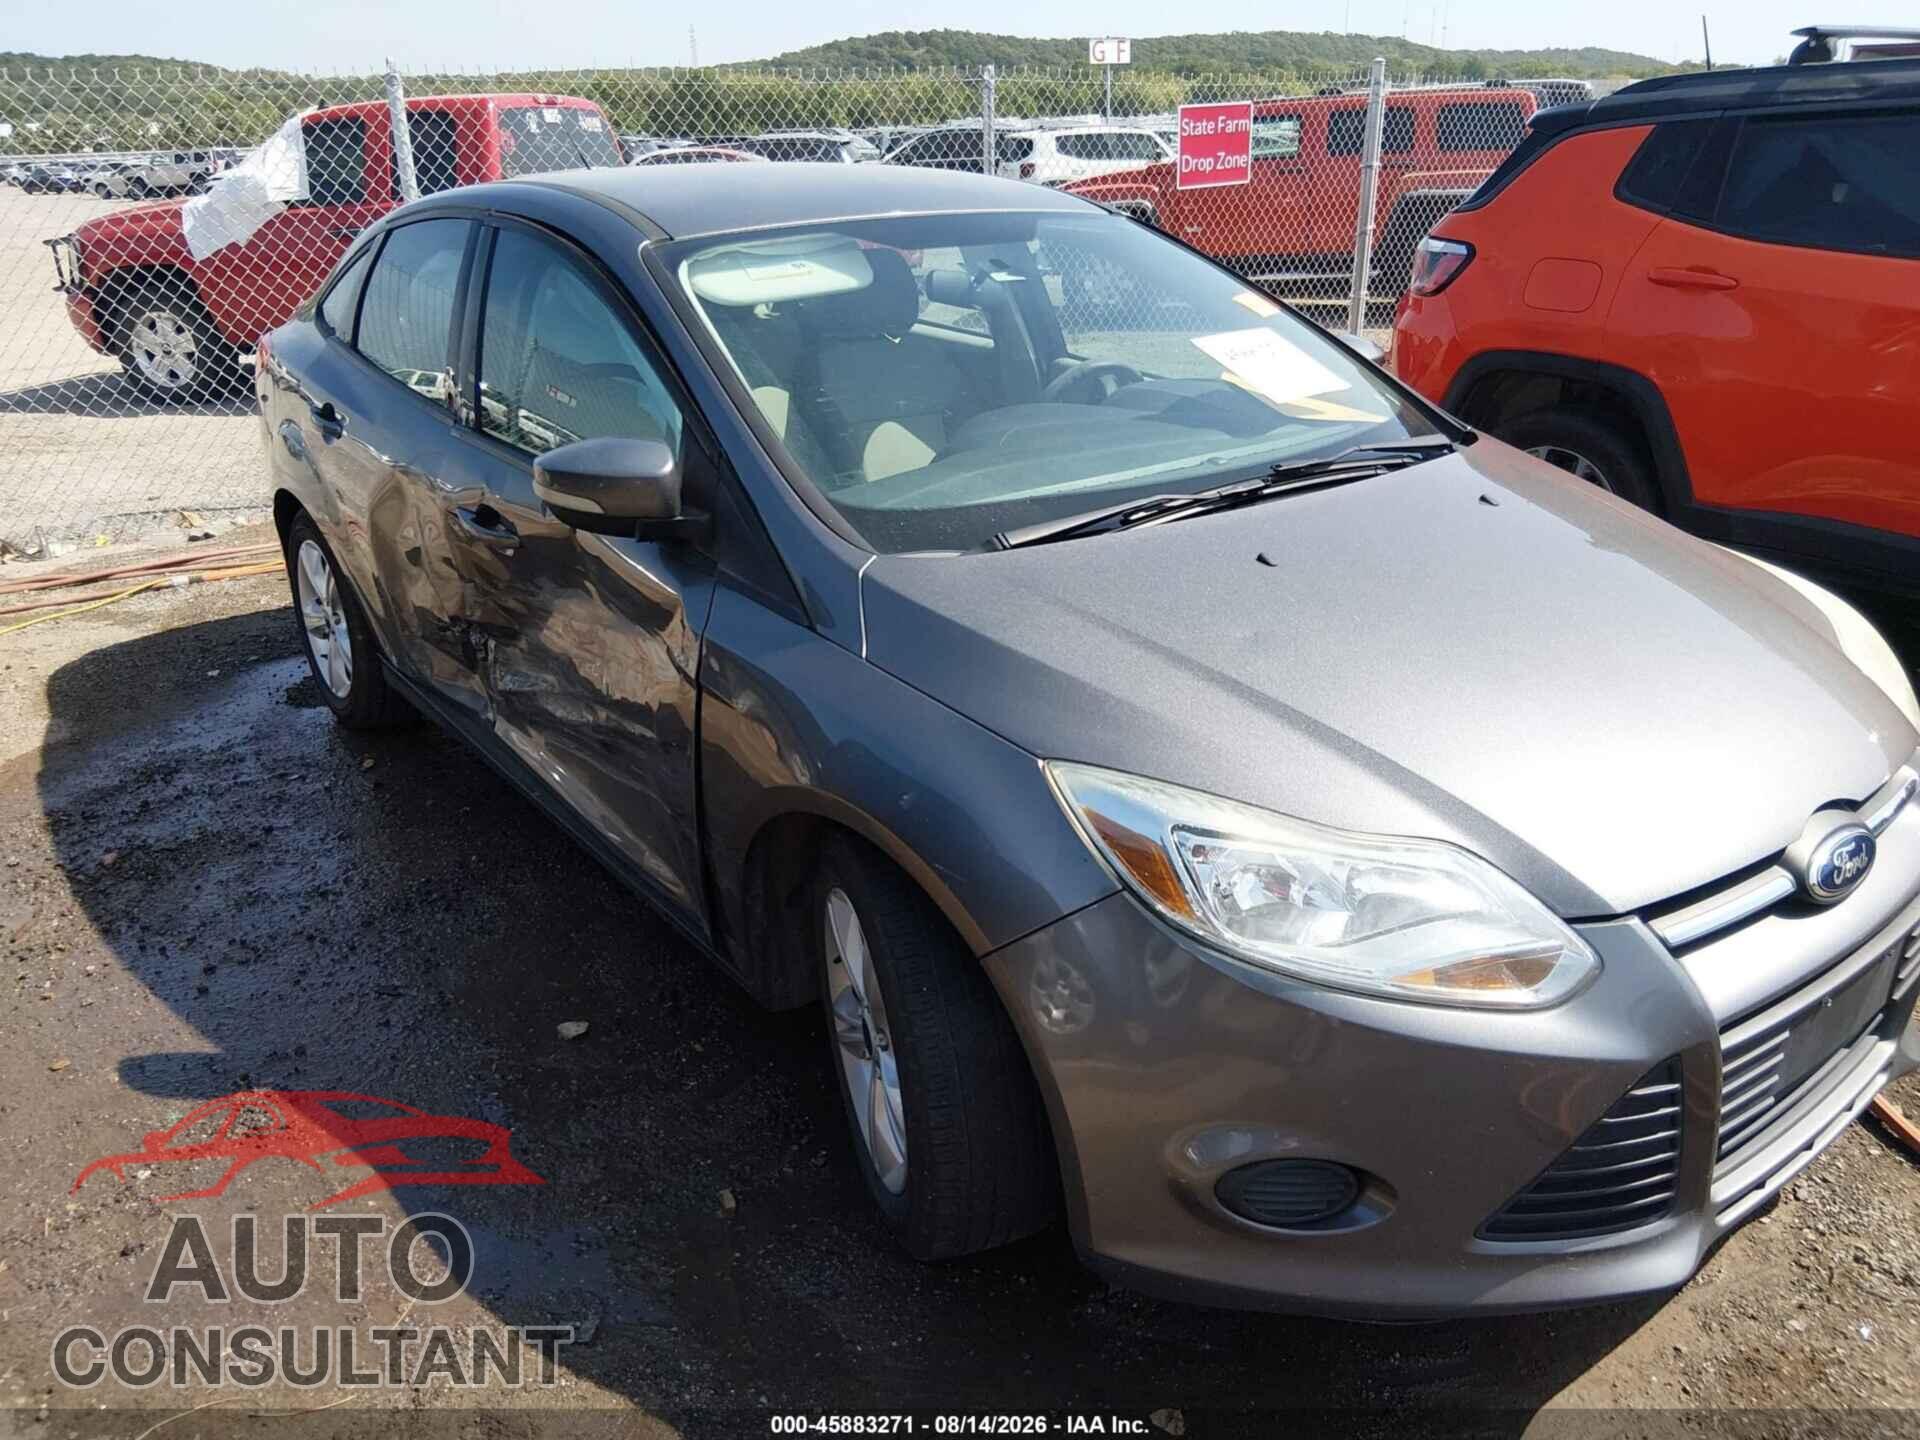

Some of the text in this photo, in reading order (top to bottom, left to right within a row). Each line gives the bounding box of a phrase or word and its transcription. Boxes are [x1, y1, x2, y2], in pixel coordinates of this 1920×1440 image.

[1091, 40, 1129, 62] G F
[1181, 115, 1250, 137] State Farm
[1181, 151, 1248, 174] Drop Zone
[1832, 840, 1869, 886] Ford
